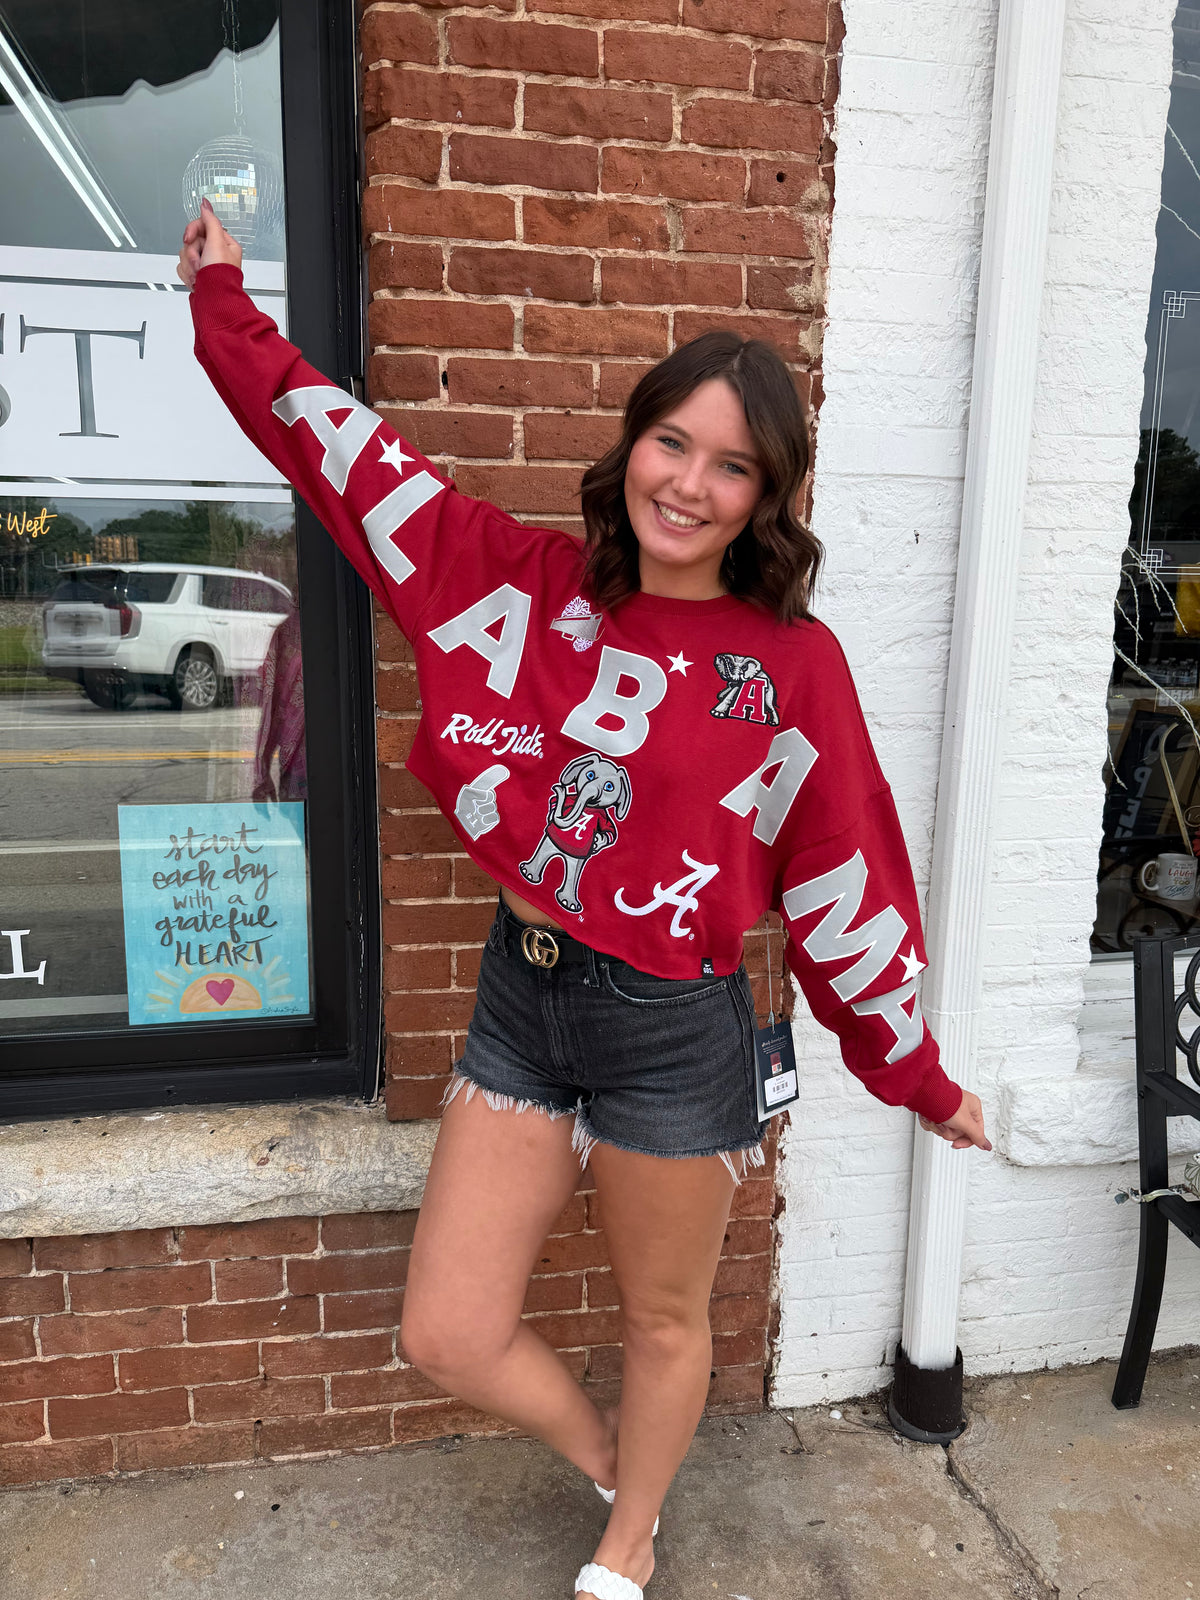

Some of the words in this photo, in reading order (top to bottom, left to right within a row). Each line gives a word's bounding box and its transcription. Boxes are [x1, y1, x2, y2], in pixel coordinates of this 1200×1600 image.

[0, 312, 147, 438] T
[7, 507, 58, 538] West
[729, 677, 768, 724] A
[440, 713, 505, 746] Roll
[164, 822, 264, 861] start
[152, 860, 220, 891] each
[222, 854, 279, 901] day
[173, 889, 213, 911] with
[227, 894, 249, 906] a
[154, 904, 278, 947] grateful
[174, 934, 273, 967] HEART
